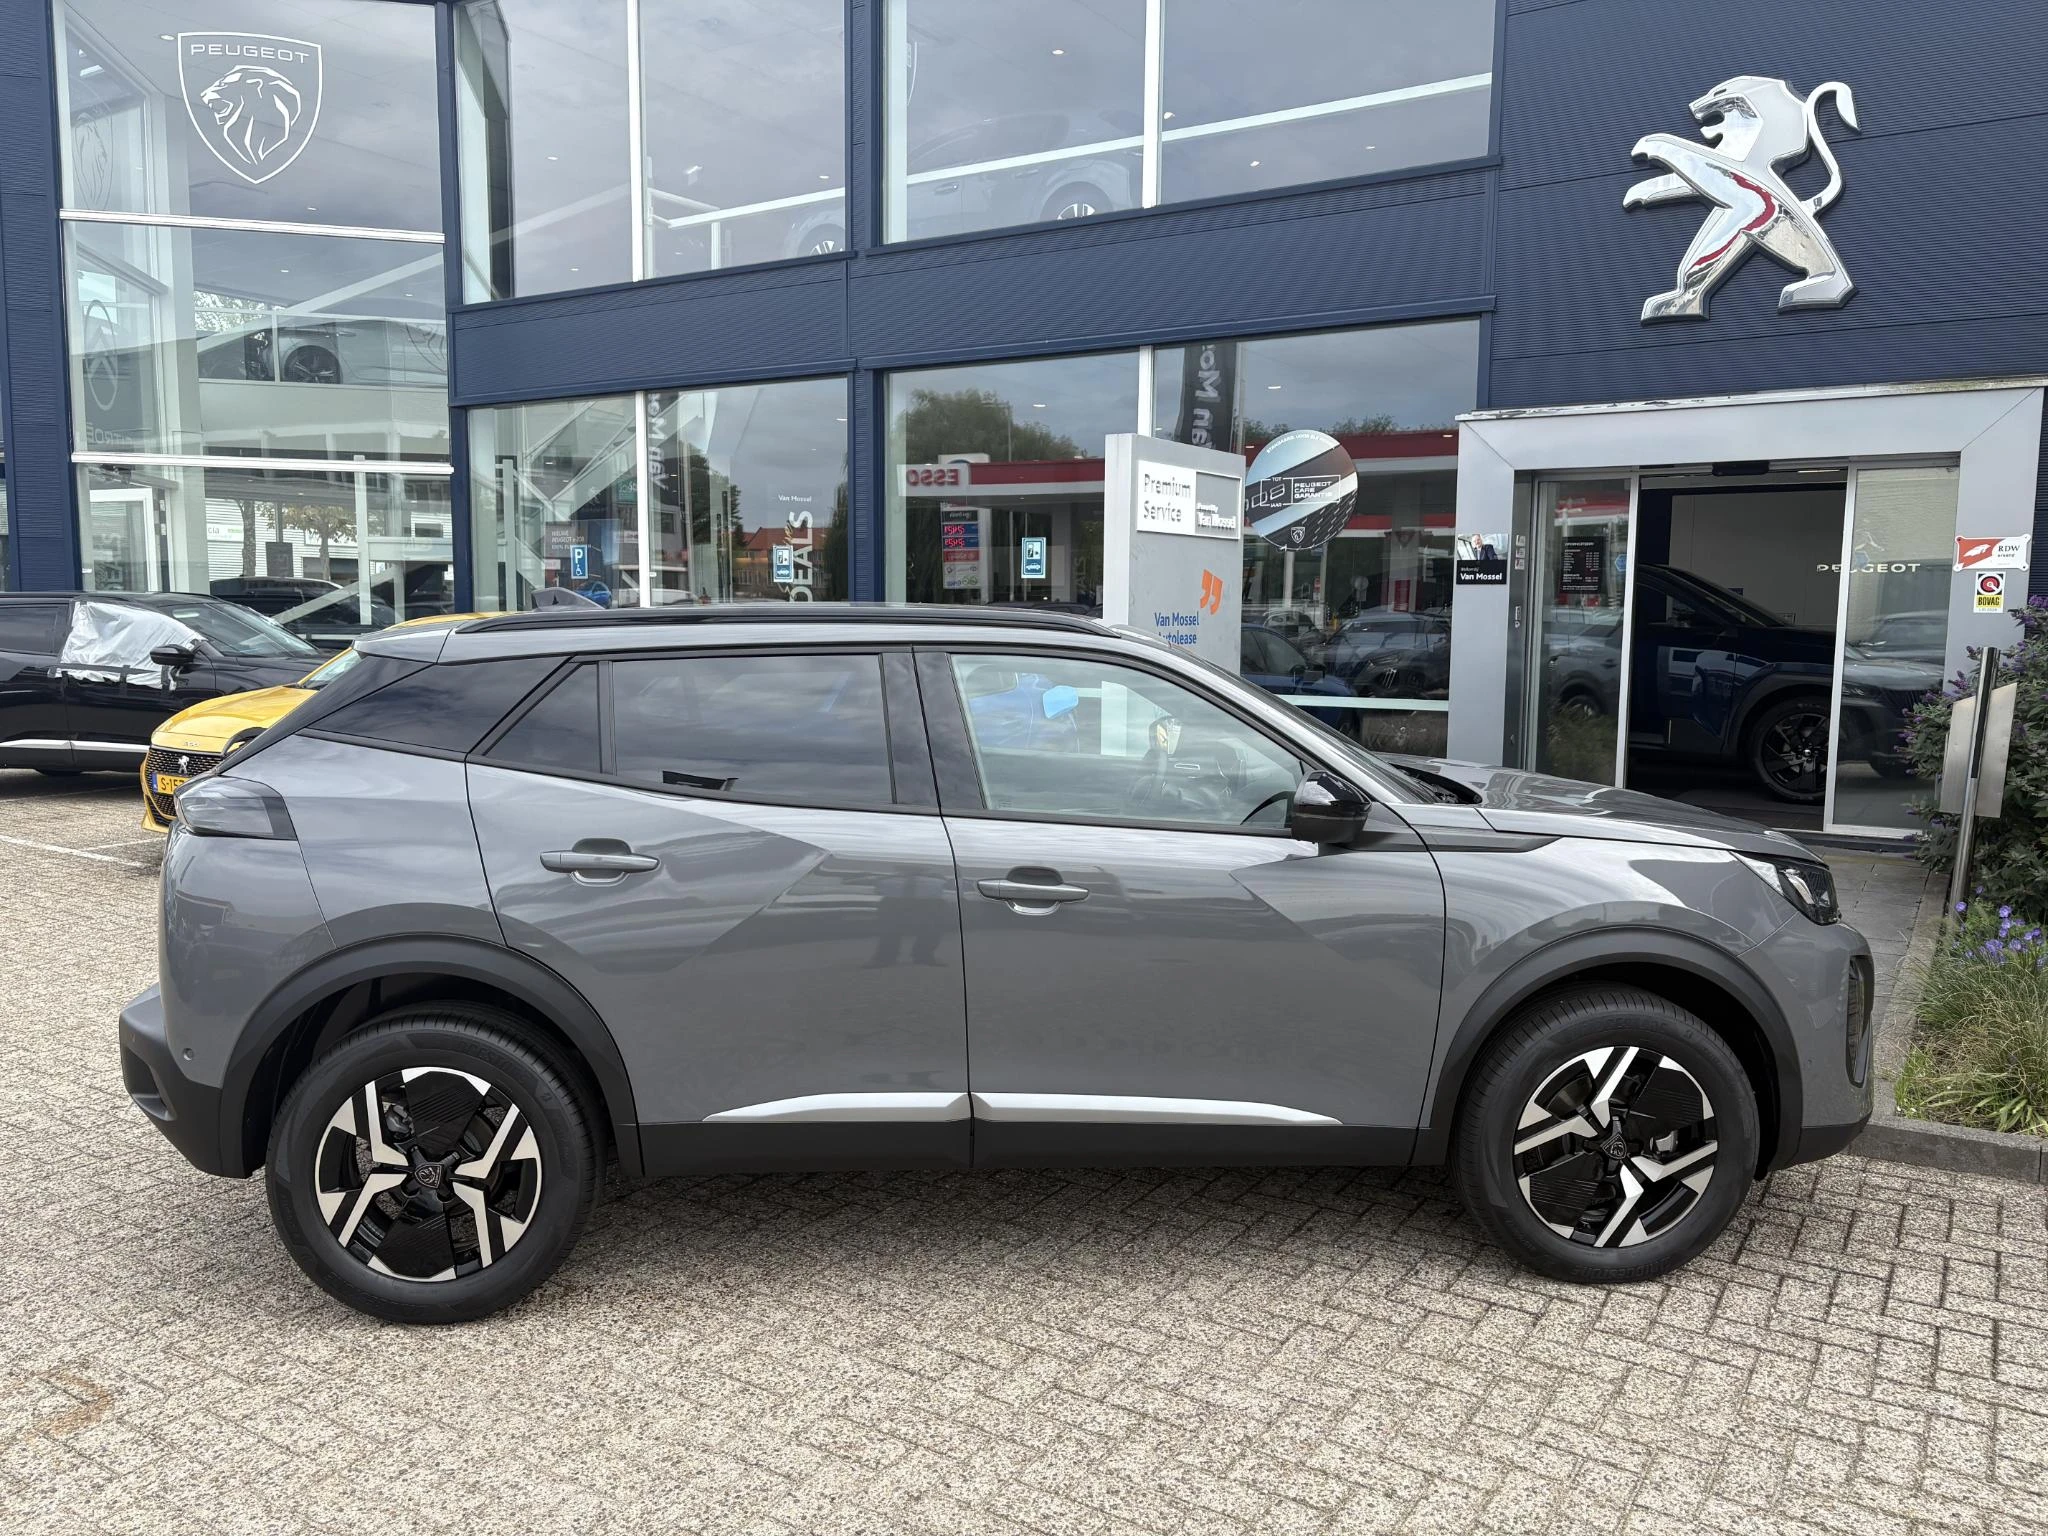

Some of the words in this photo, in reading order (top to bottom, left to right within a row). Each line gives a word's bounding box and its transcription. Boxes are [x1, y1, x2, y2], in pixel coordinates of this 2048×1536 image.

[190, 43, 310, 64] PEUGEOT
[1144, 473, 1192, 498] Premium
[1143, 500, 1182, 522] Service
[1197, 512, 1211, 528] Van
[1212, 514, 1237, 530] Mossel
[574, 548, 583, 563] P
[788, 511, 814, 602] DEALS
[1460, 572, 1474, 580] Van
[1475, 572, 1503, 581] Mossel
[1978, 596, 2000, 606] BOVAG
[1154, 612, 1170, 627] Van
[1172, 610, 1200, 627] Mossel
[1159, 629, 1197, 645] tolease
